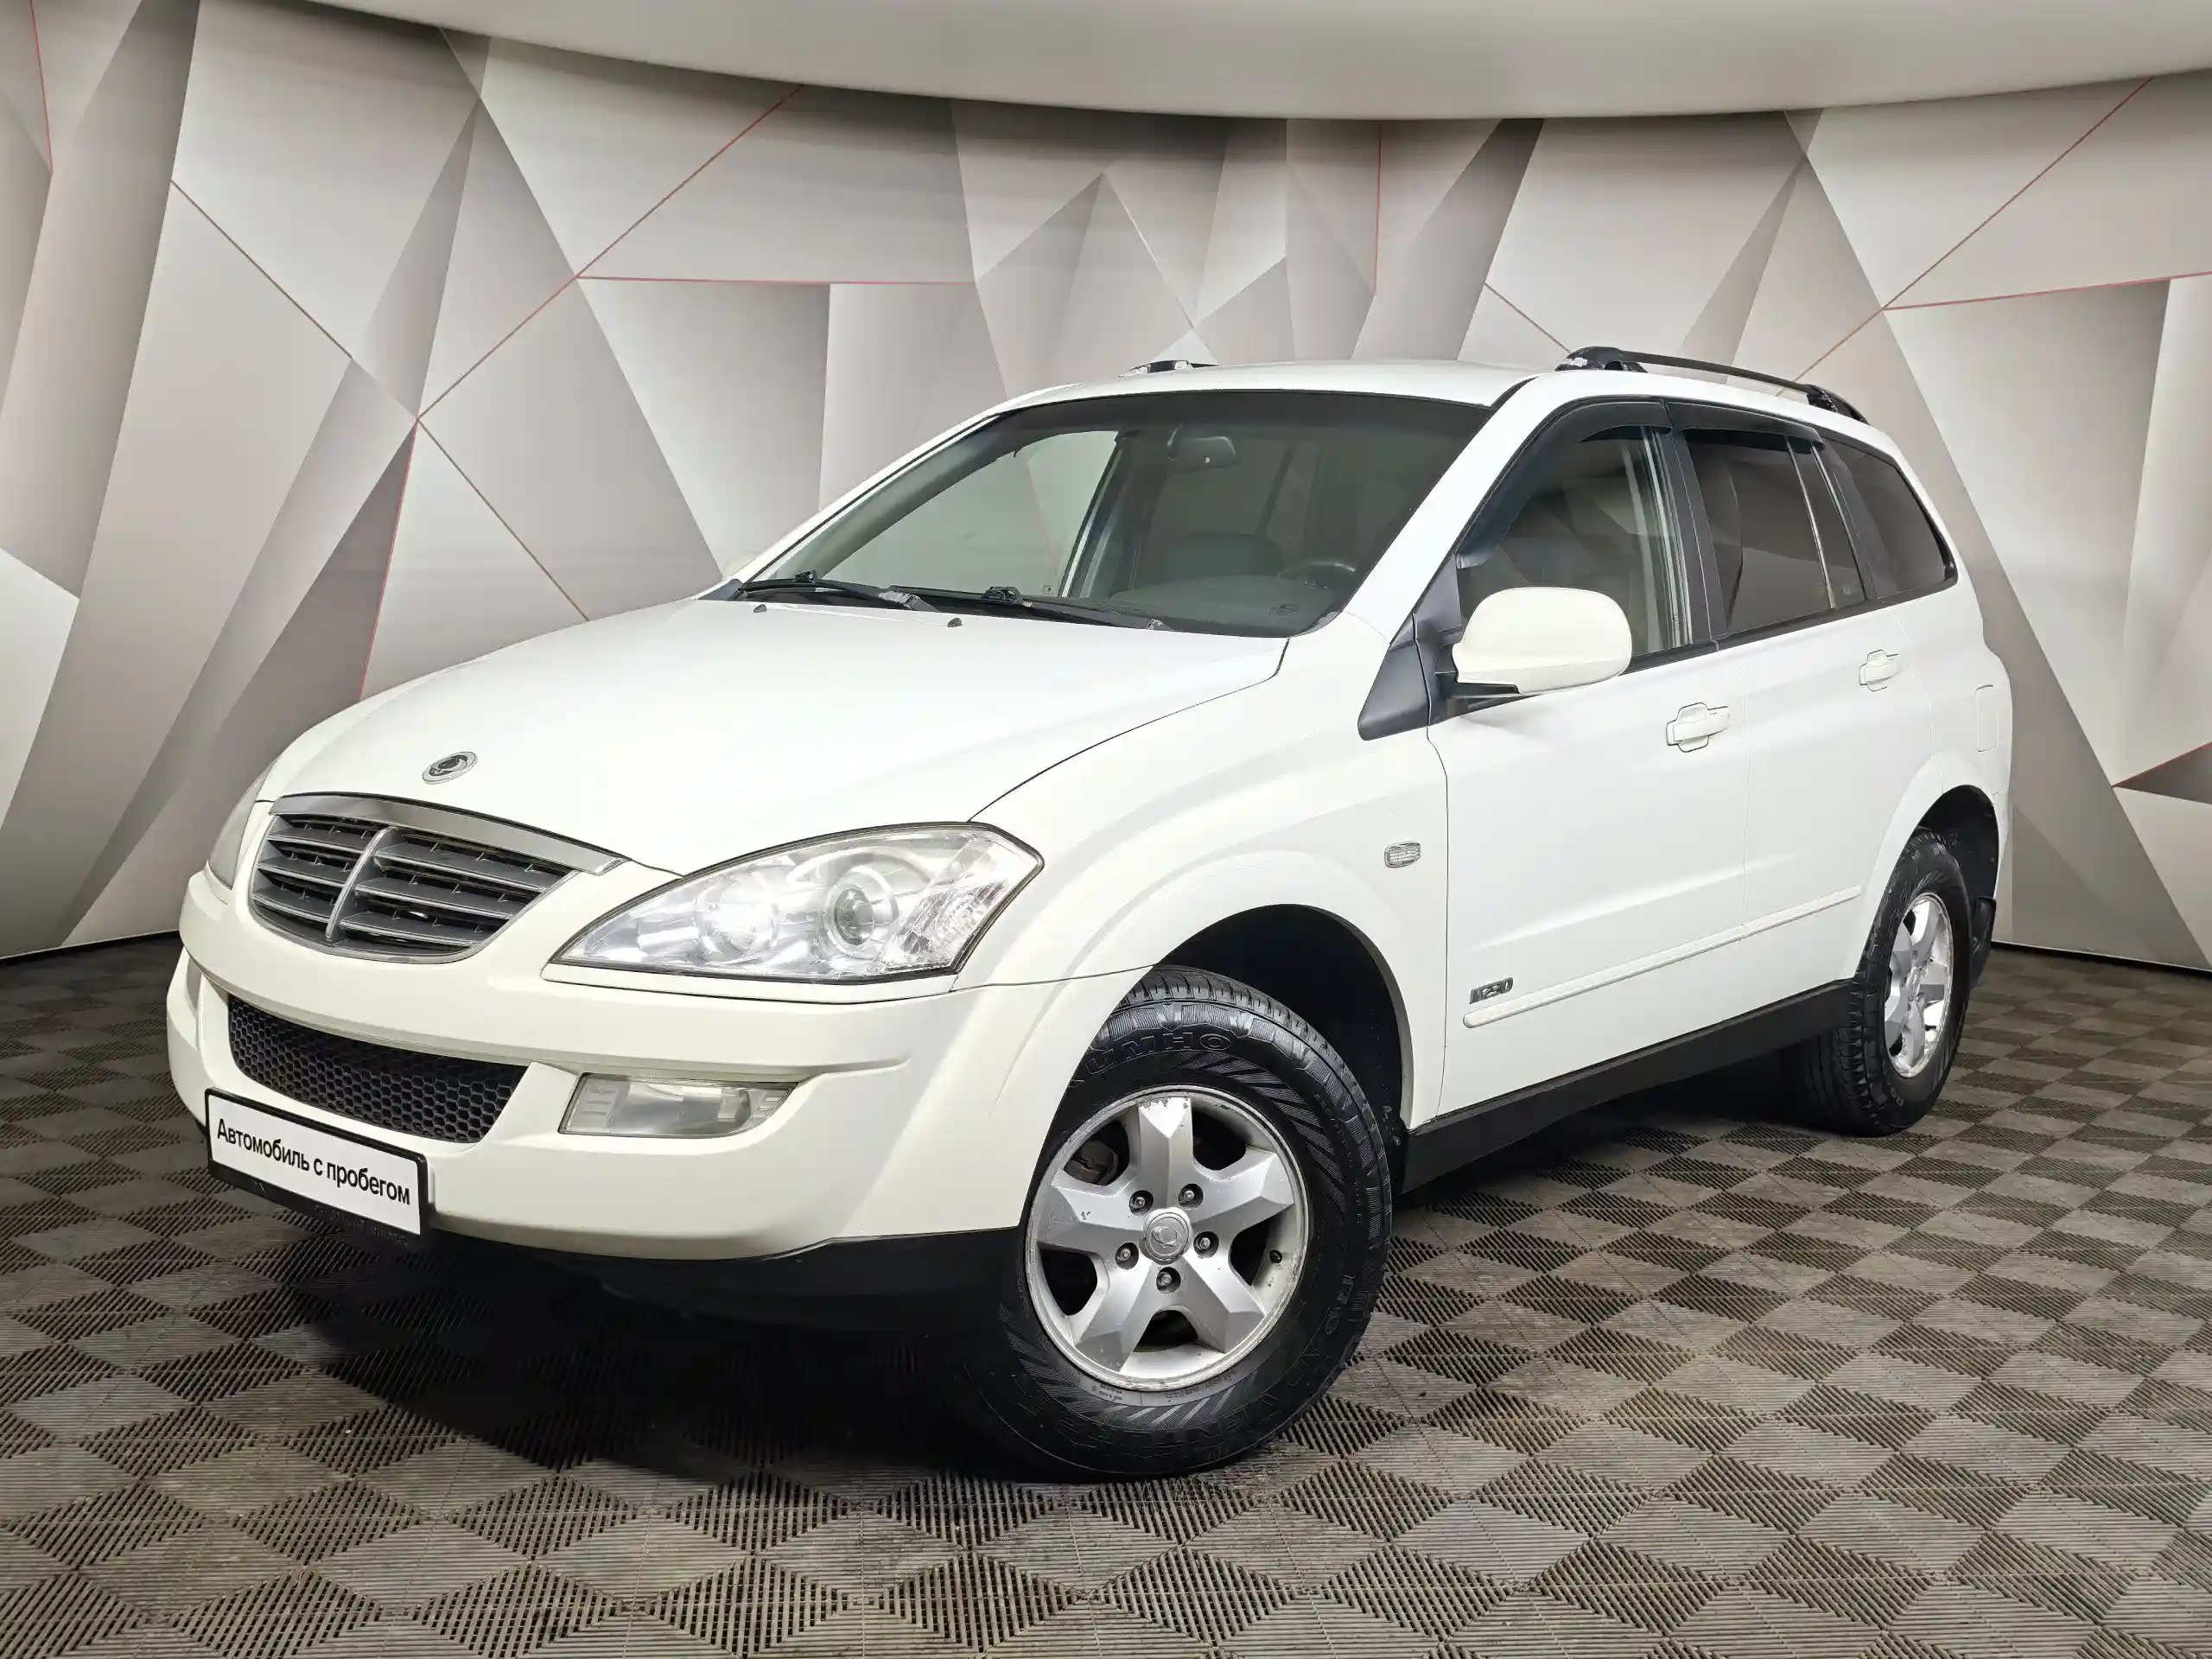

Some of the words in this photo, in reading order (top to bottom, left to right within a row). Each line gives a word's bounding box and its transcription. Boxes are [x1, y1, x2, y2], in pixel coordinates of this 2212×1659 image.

[1070, 1032, 1231, 1087] UMHO
[217, 1118, 310, 1172] Автомобиль
[314, 1158, 323, 1176] с
[327, 1161, 410, 1205] пробегом
